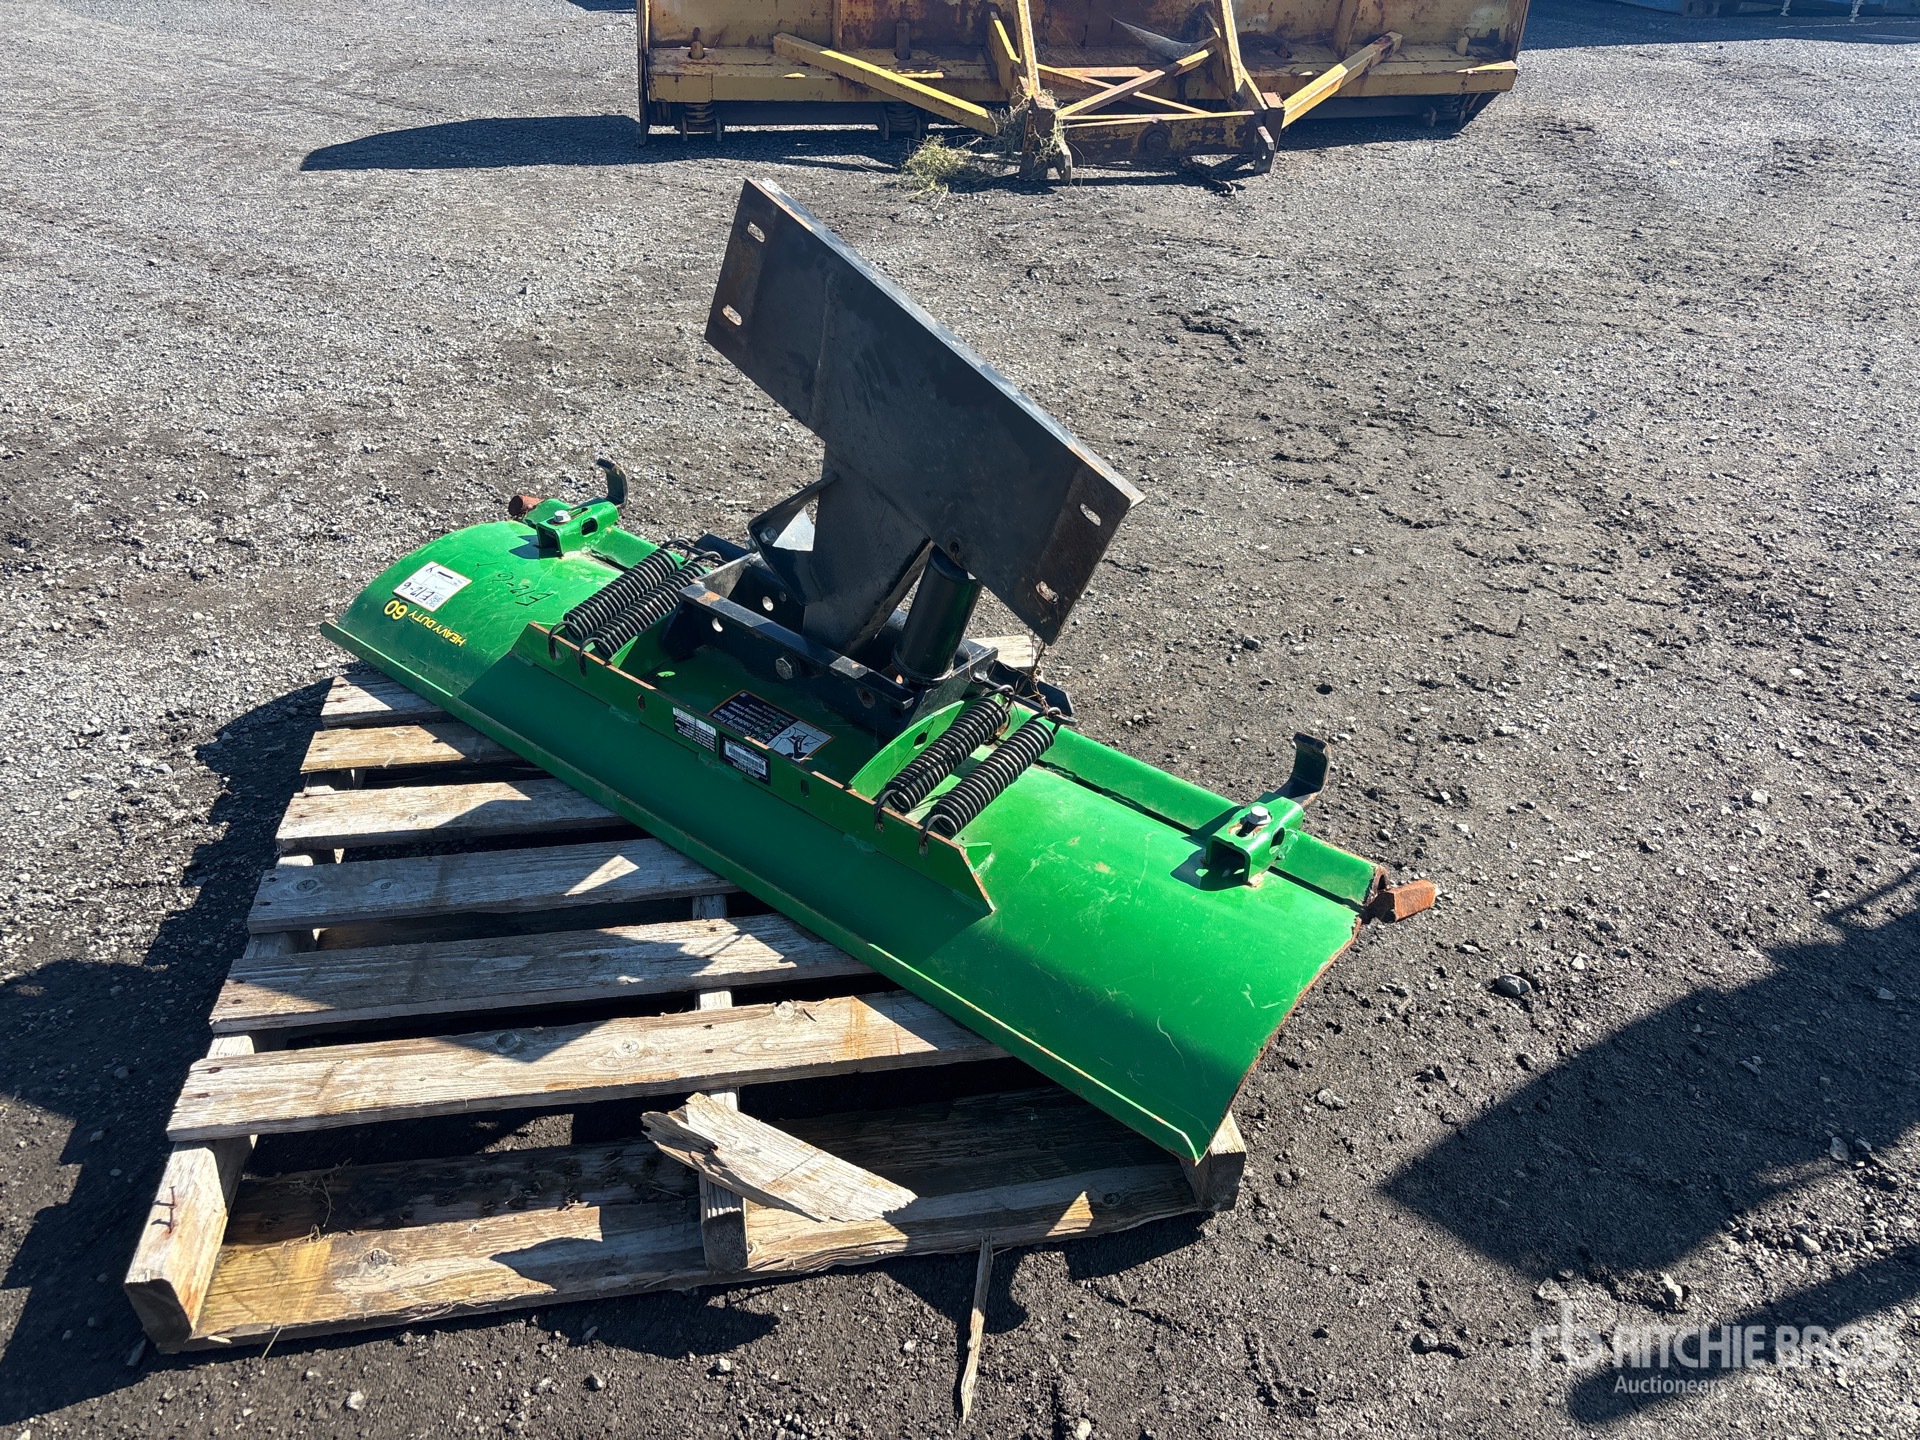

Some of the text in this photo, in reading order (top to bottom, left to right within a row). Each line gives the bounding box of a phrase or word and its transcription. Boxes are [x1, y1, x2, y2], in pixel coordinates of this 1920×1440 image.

[383, 599, 467, 647] HEAVY DUTY 60
